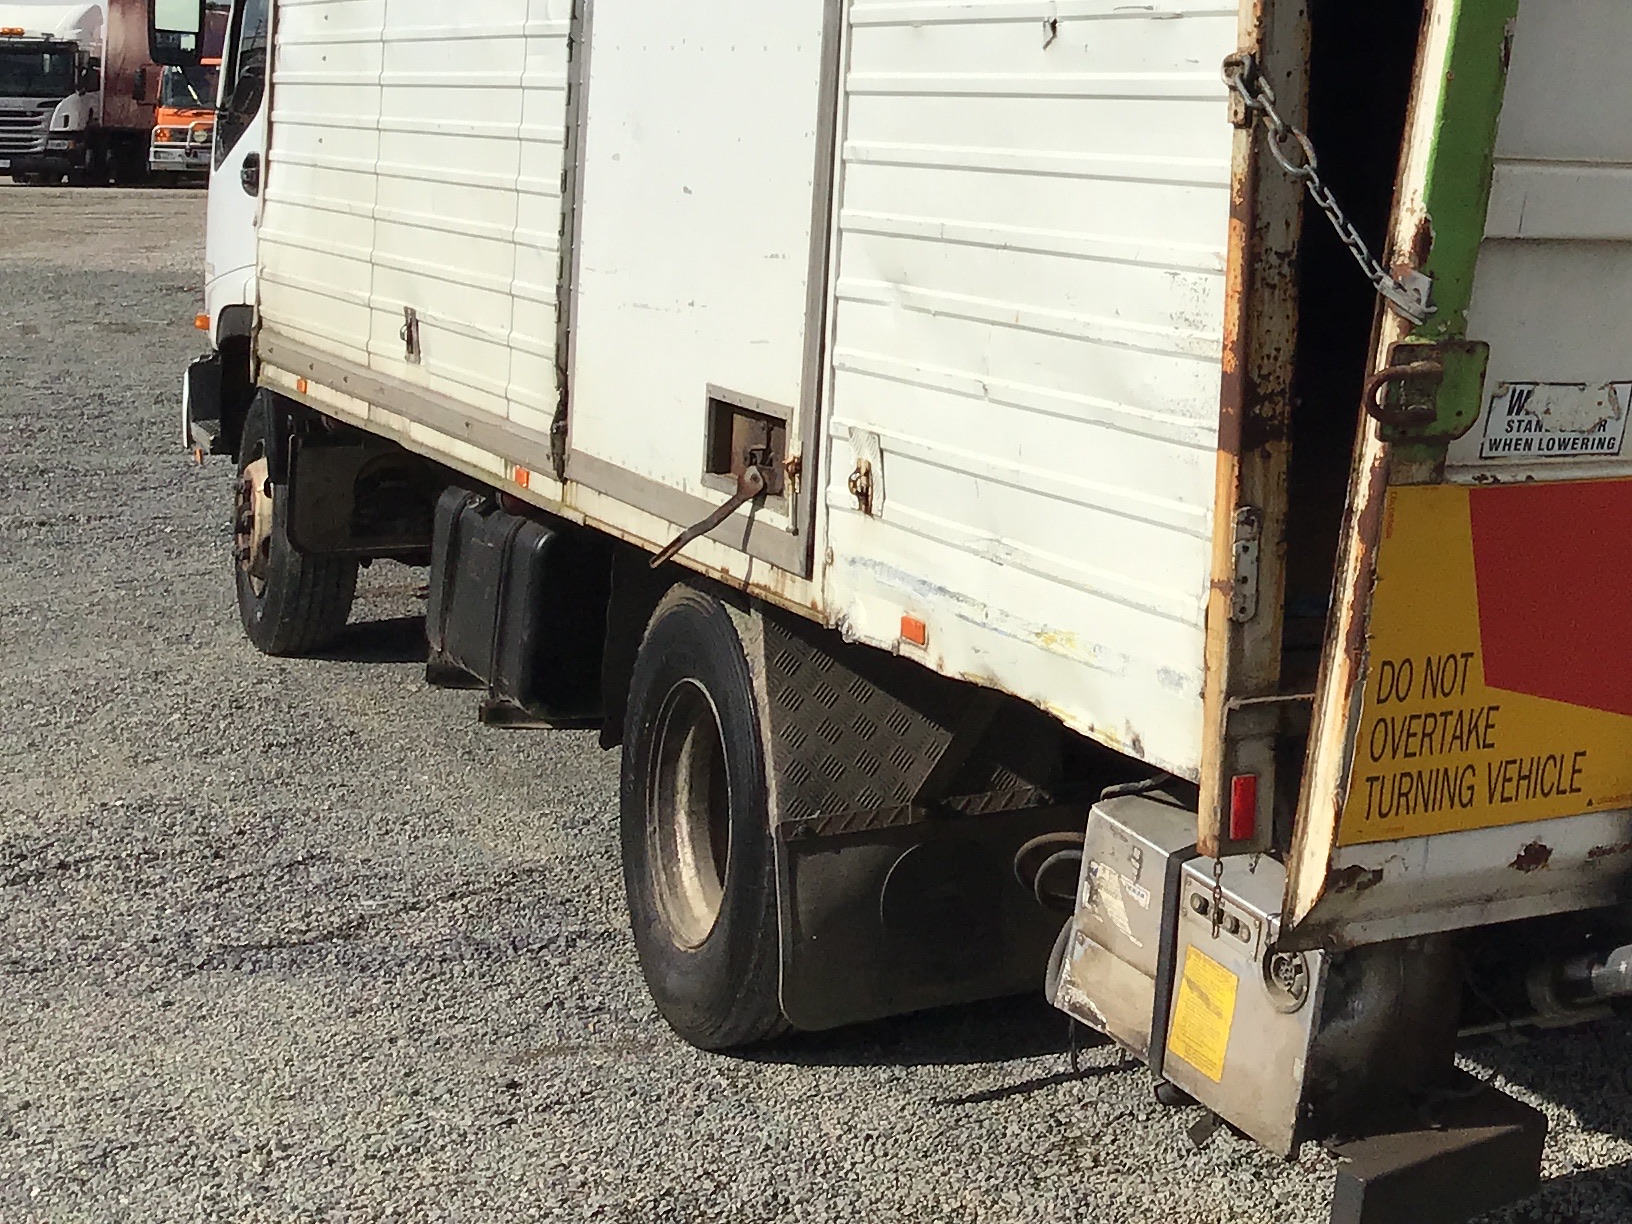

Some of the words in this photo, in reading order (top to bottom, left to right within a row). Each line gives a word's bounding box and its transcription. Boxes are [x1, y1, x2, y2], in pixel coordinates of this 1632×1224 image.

[1488, 437, 1534, 452] WHEN
[1537, 436, 1617, 451] LOWERING
[1376, 658, 1413, 705] DO
[1421, 652, 1475, 700] NOT
[1369, 706, 1501, 763] OVERTAKE
[1364, 763, 1477, 821] TURNING
[1487, 751, 1587, 805] VEHICLE
